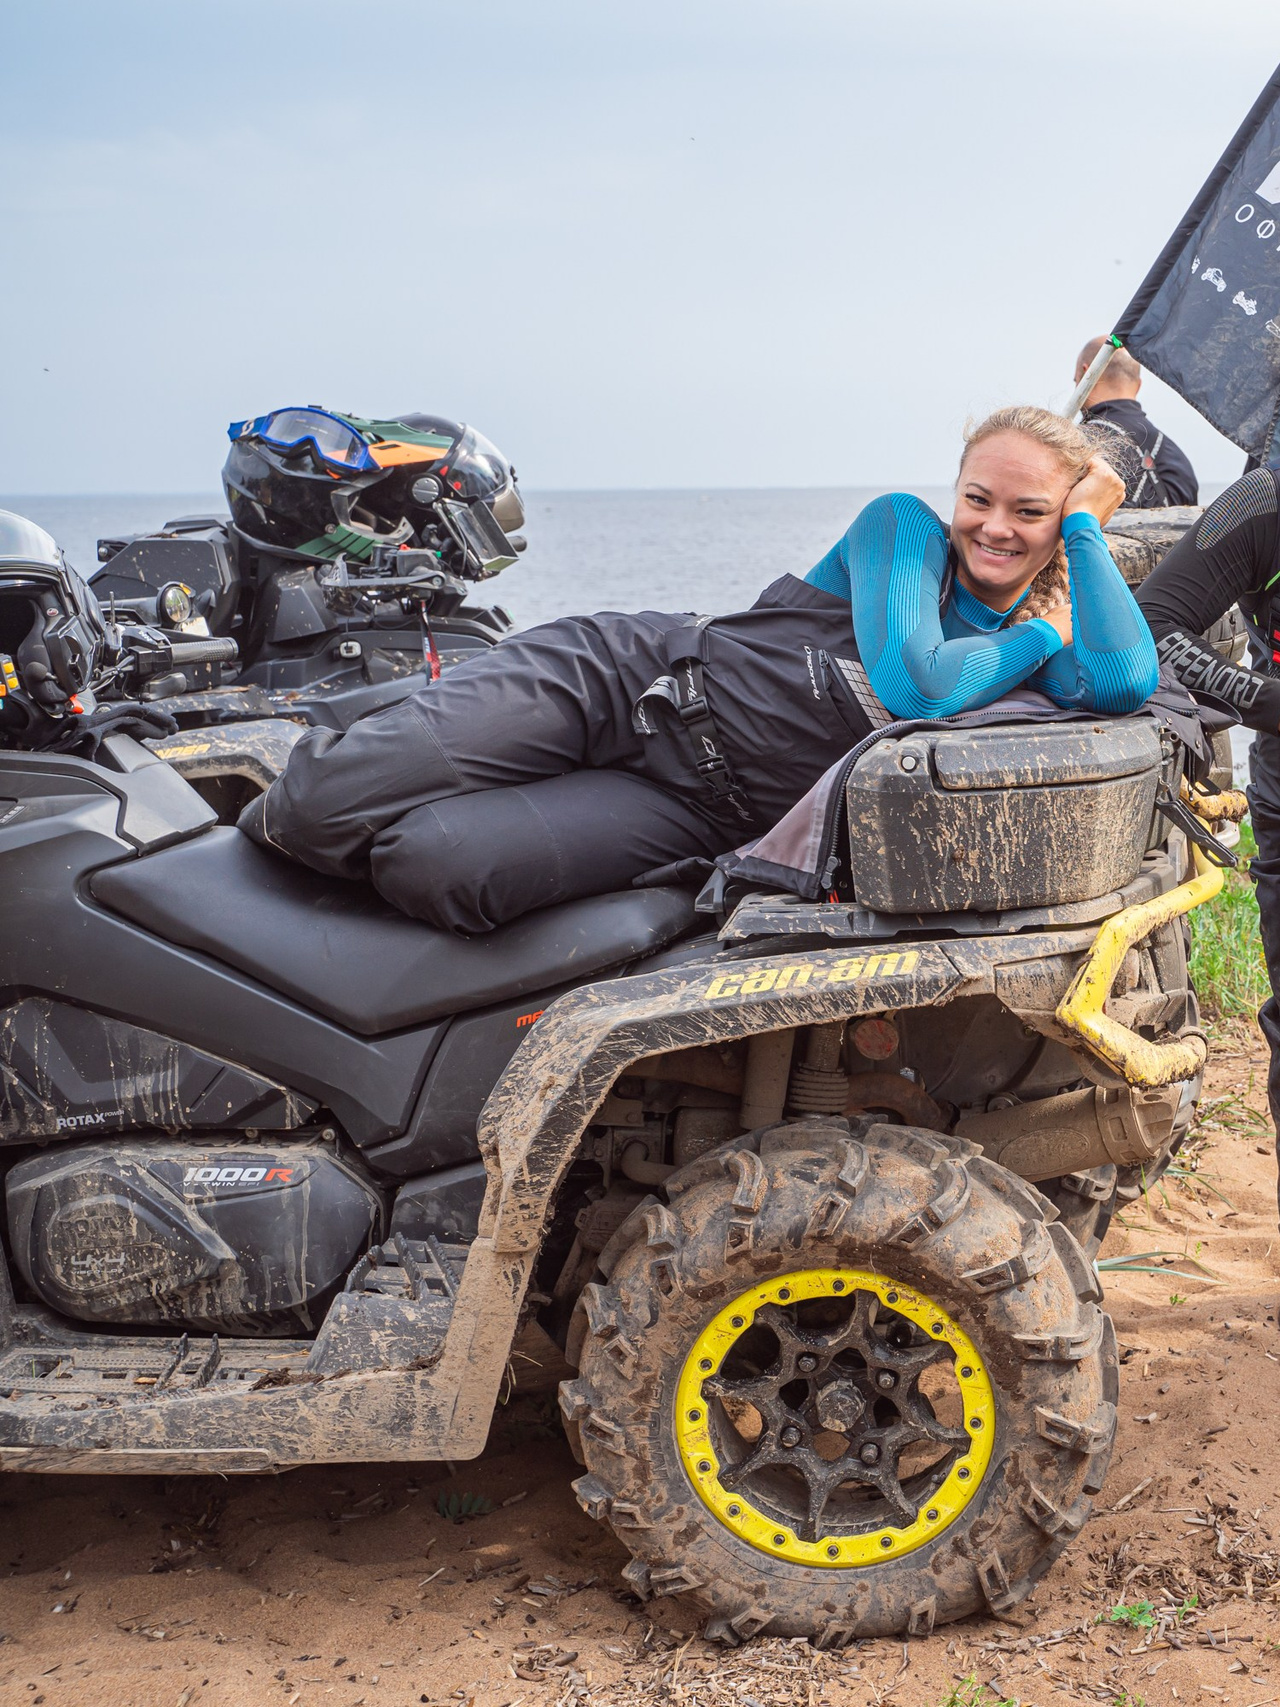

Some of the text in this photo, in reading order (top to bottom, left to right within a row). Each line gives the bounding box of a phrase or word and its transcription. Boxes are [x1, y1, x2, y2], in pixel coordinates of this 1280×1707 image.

[1156, 631, 1265, 710] FREENORD
[704, 950, 921, 1000] can-am
[57, 1113, 106, 1130] ROTAX
[182, 1167, 294, 1182] 1000R
